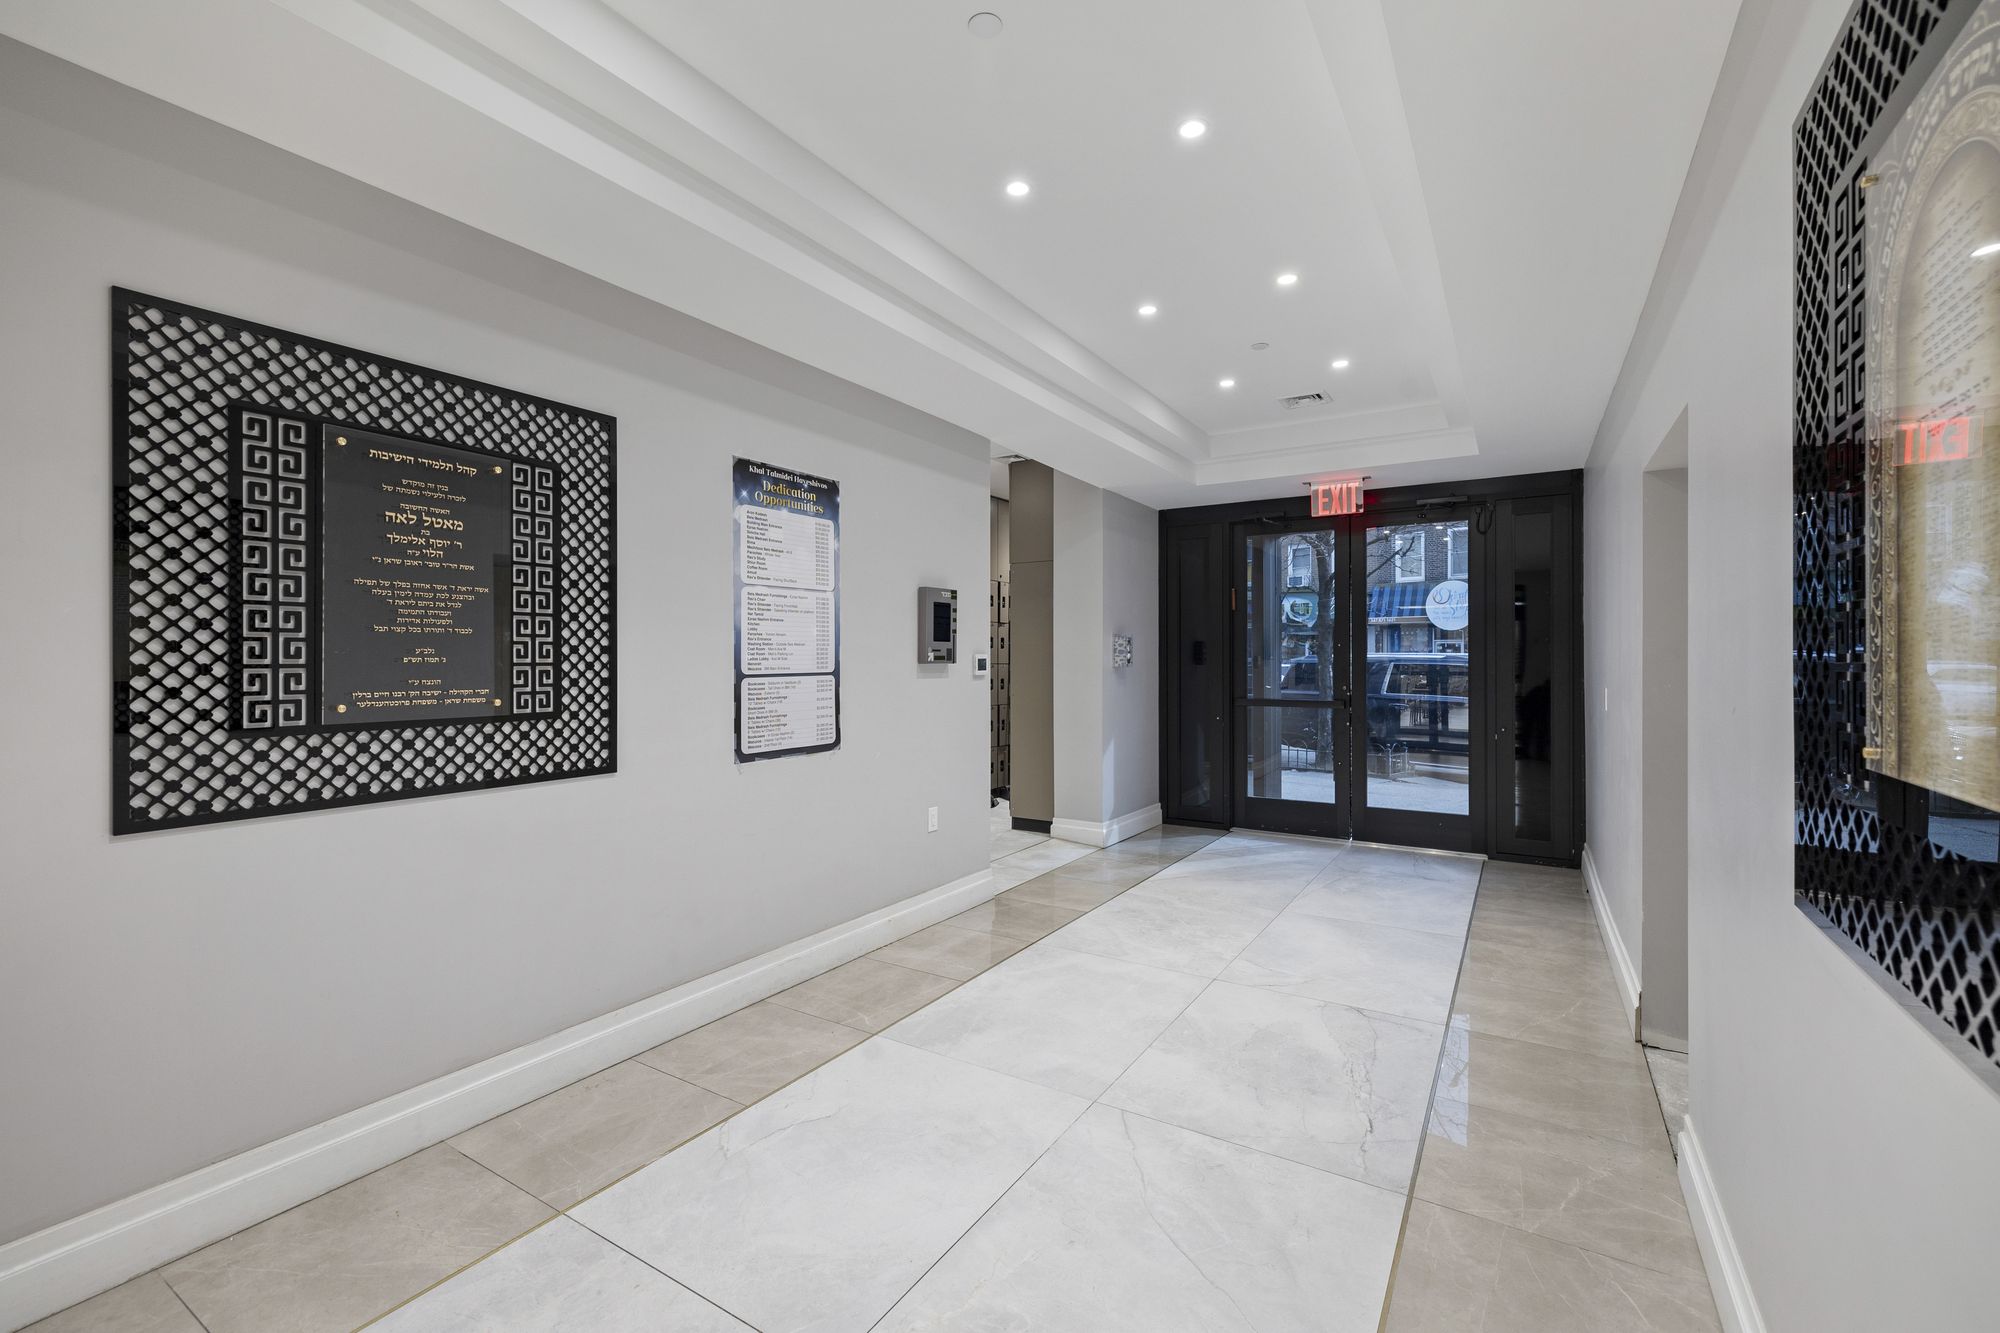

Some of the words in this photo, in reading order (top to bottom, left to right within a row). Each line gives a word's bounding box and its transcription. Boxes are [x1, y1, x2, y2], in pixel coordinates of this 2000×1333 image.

[369, 449, 414, 464] הישיבות
[418, 458, 453, 471] תלמידי
[457, 462, 477, 477] קהל
[749, 465, 764, 475] Khal
[766, 469, 793, 482] Talmidei
[794, 476, 828, 489] Hayeshivos
[382, 483, 393, 491] של
[763, 480, 816, 501] Dedication
[755, 491, 824, 514] Opportunities
[1319, 482, 1359, 515] EXIT
[385, 510, 417, 524] לאה
[422, 512, 463, 531] מאטל
[387, 532, 425, 545] אלימלך
[430, 539, 450, 548] יוסף
[422, 548, 443, 558] הלוי
